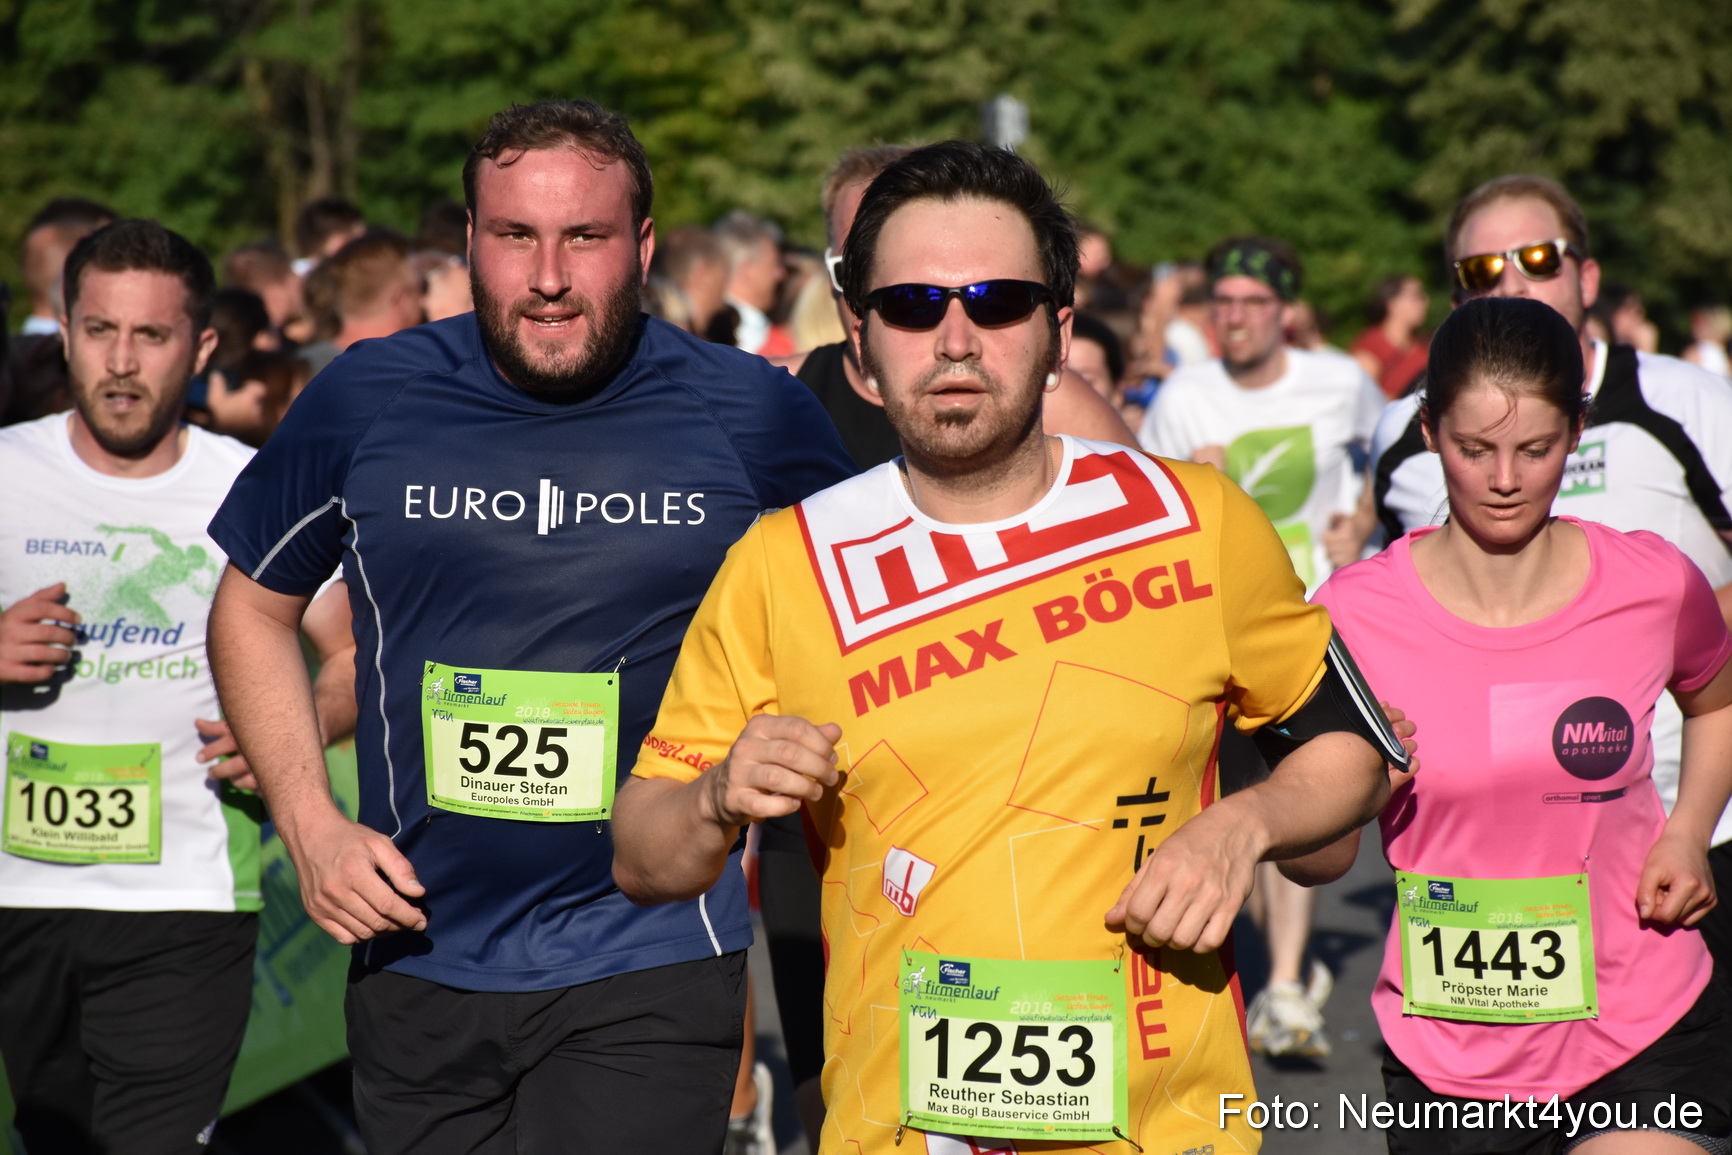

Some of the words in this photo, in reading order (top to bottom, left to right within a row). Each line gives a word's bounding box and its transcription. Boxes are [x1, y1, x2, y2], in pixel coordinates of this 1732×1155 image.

[404, 485, 526, 521] EURO
[575, 492, 706, 525] POLES
[26, 539, 106, 557] BERATA
[848, 618, 1019, 717] MAX
[1033, 559, 1213, 644] BÖGL
[444, 689, 508, 707] firmenlauf
[515, 706, 550, 719] 2018
[458, 721, 569, 779] 525
[1562, 744, 1628, 757] apotheke
[460, 776, 515, 794] Dinauer
[519, 781, 568, 795] Stefan
[20, 782, 135, 829] 1033
[471, 793, 519, 807] Europoles
[522, 797, 554, 807] GmbH
[32, 826, 60, 839] Klein
[64, 830, 118, 842] Willibald
[1419, 897, 1479, 913] firmenlauf
[1488, 912, 1523, 924] 2018
[1422, 927, 1566, 980] 1443
[925, 980, 1000, 1001] firmenlauf
[1442, 981, 1502, 997] Pröpster
[1507, 985, 1548, 997] Marie
[1010, 1001, 1052, 1015] 2018
[1451, 997, 1465, 1005] NM
[1492, 1000, 1540, 1010] Apotheke
[924, 1017, 1096, 1087] 1253
[929, 1083, 995, 1104] Reuther
[1001, 1090, 1090, 1106] Sebastian
[927, 1101, 949, 1113] Max
[952, 1103, 978, 1118] Bögl
[982, 1107, 1049, 1120] Bauservice
[1052, 1111, 1090, 1121] GmbH
